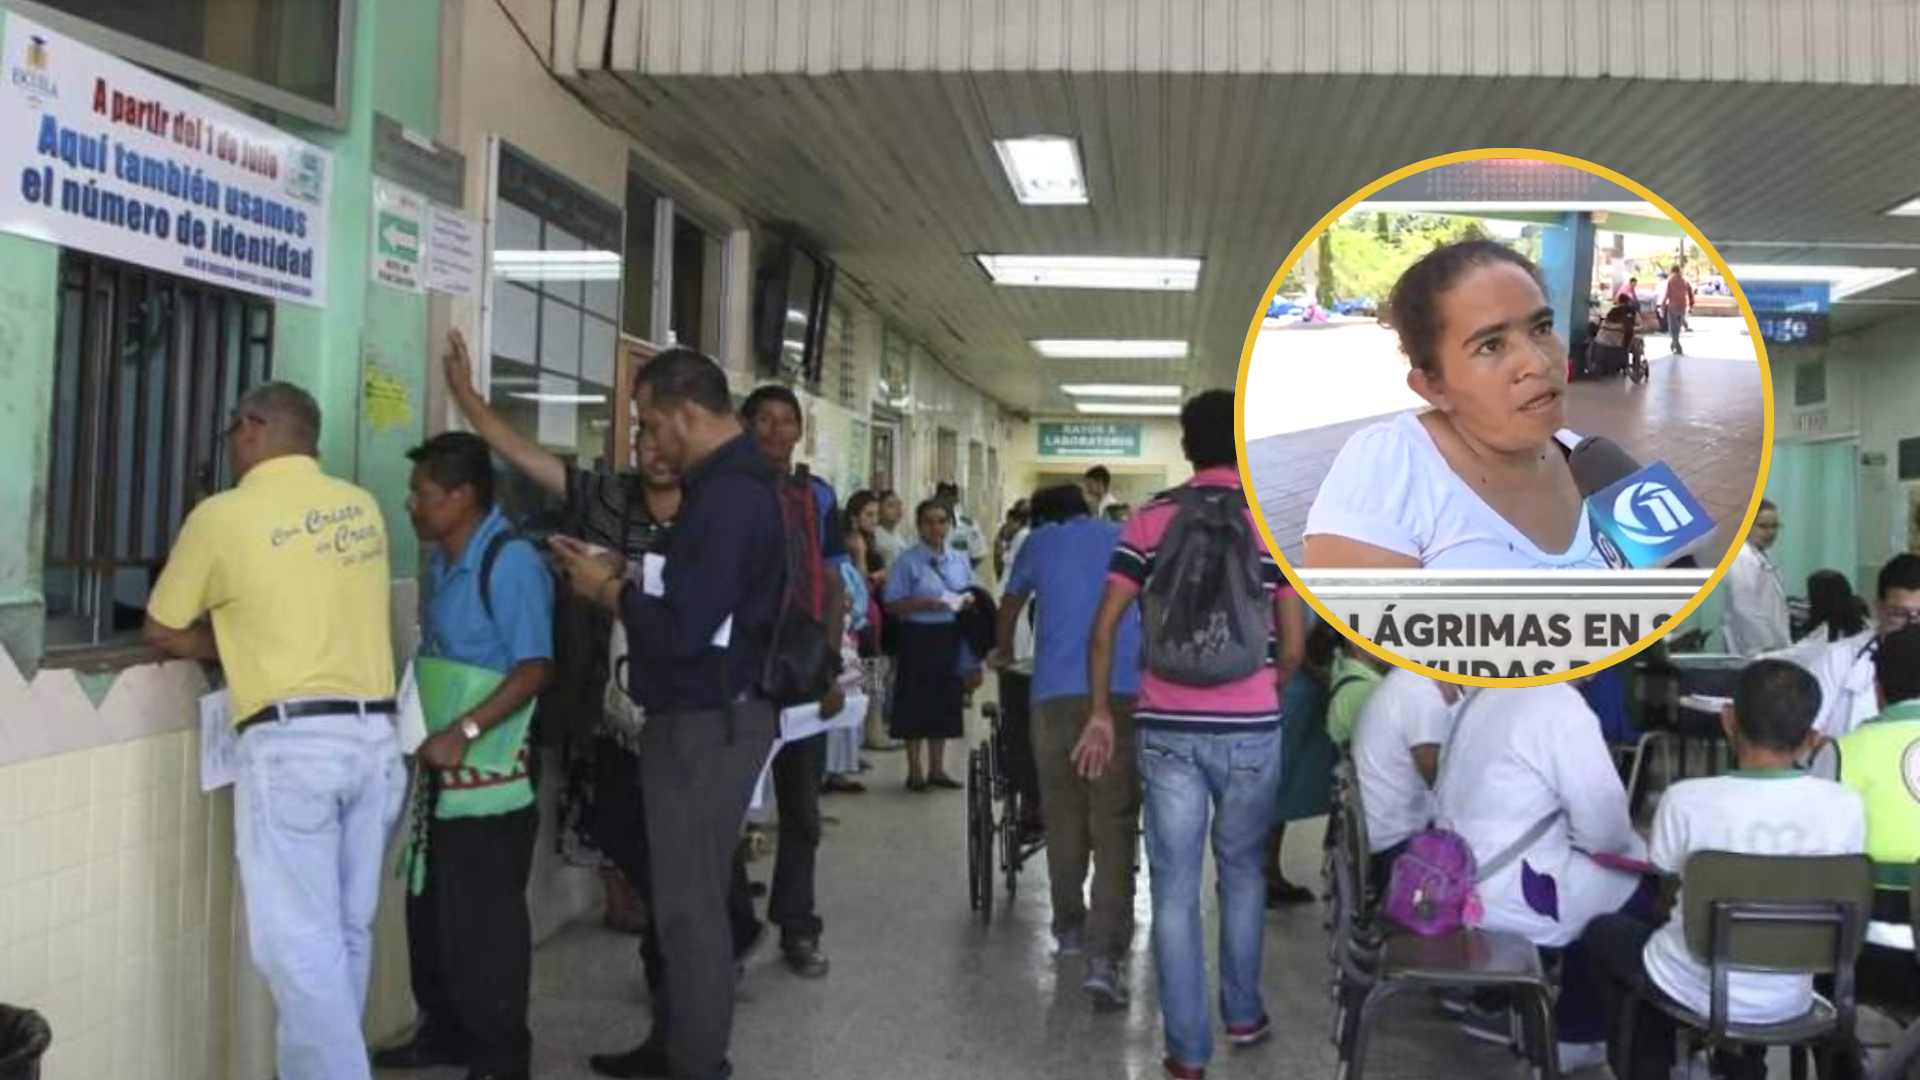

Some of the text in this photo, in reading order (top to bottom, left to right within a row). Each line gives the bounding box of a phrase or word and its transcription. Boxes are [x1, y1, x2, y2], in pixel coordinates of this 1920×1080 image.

[92, 76, 106, 115] A
[111, 90, 169, 137] partir
[173, 111, 202, 151] del
[217, 131, 238, 166] de
[21, 166, 53, 207] el
[61, 178, 170, 240] número
[176, 208, 207, 250] de
[211, 219, 312, 279] identidad
[37, 113, 108, 173] Aquí
[115, 142, 220, 211] también
[224, 185, 307, 239] usamos
[1044, 436, 1135, 447] LABORATORIO
